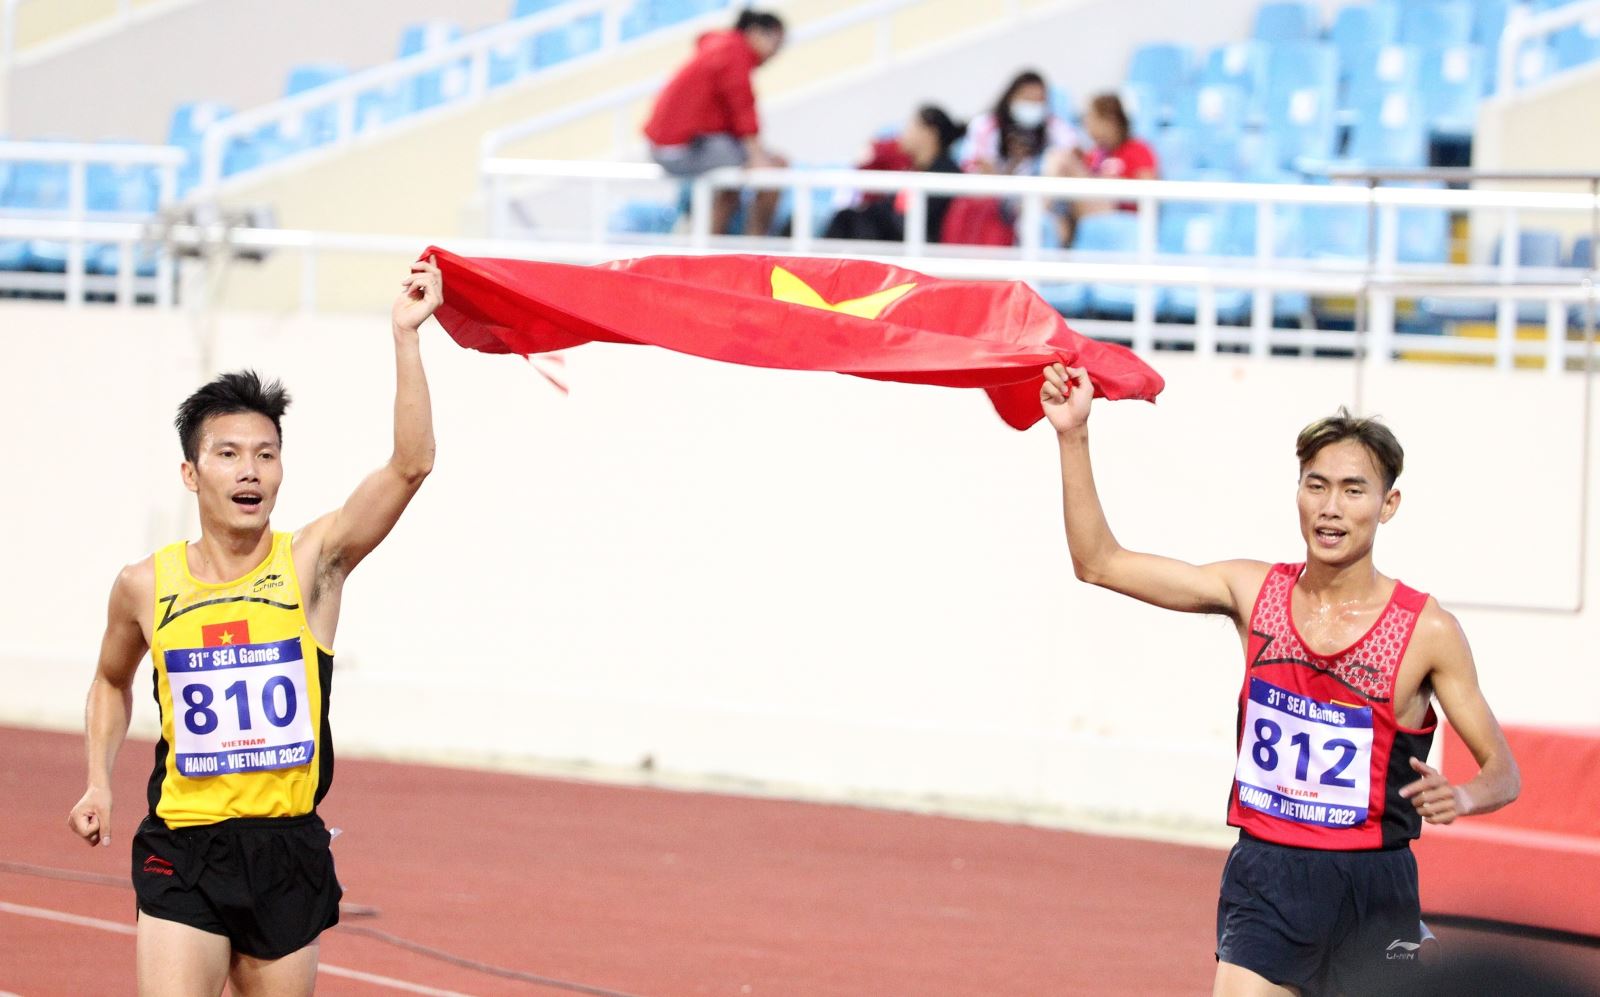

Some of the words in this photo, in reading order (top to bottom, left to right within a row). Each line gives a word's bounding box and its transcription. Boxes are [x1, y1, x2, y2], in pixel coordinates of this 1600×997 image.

[212, 650, 237, 666] SEA
[239, 647, 280, 664] Games
[182, 675, 298, 735] 810
[1287, 695, 1306, 715] SEA
[1309, 702, 1346, 724] Games
[221, 737, 266, 748] VIETNAM
[1252, 717, 1358, 788] 812
[184, 756, 218, 773] HANOI
[227, 750, 277, 770] VIETNAM
[279, 746, 307, 764] 2022
[1239, 785, 1272, 810] HANOI
[1280, 798, 1326, 822] VIETNAM
[1328, 809, 1356, 825] 2022
[1277, 784, 1319, 799] VIETNAM
